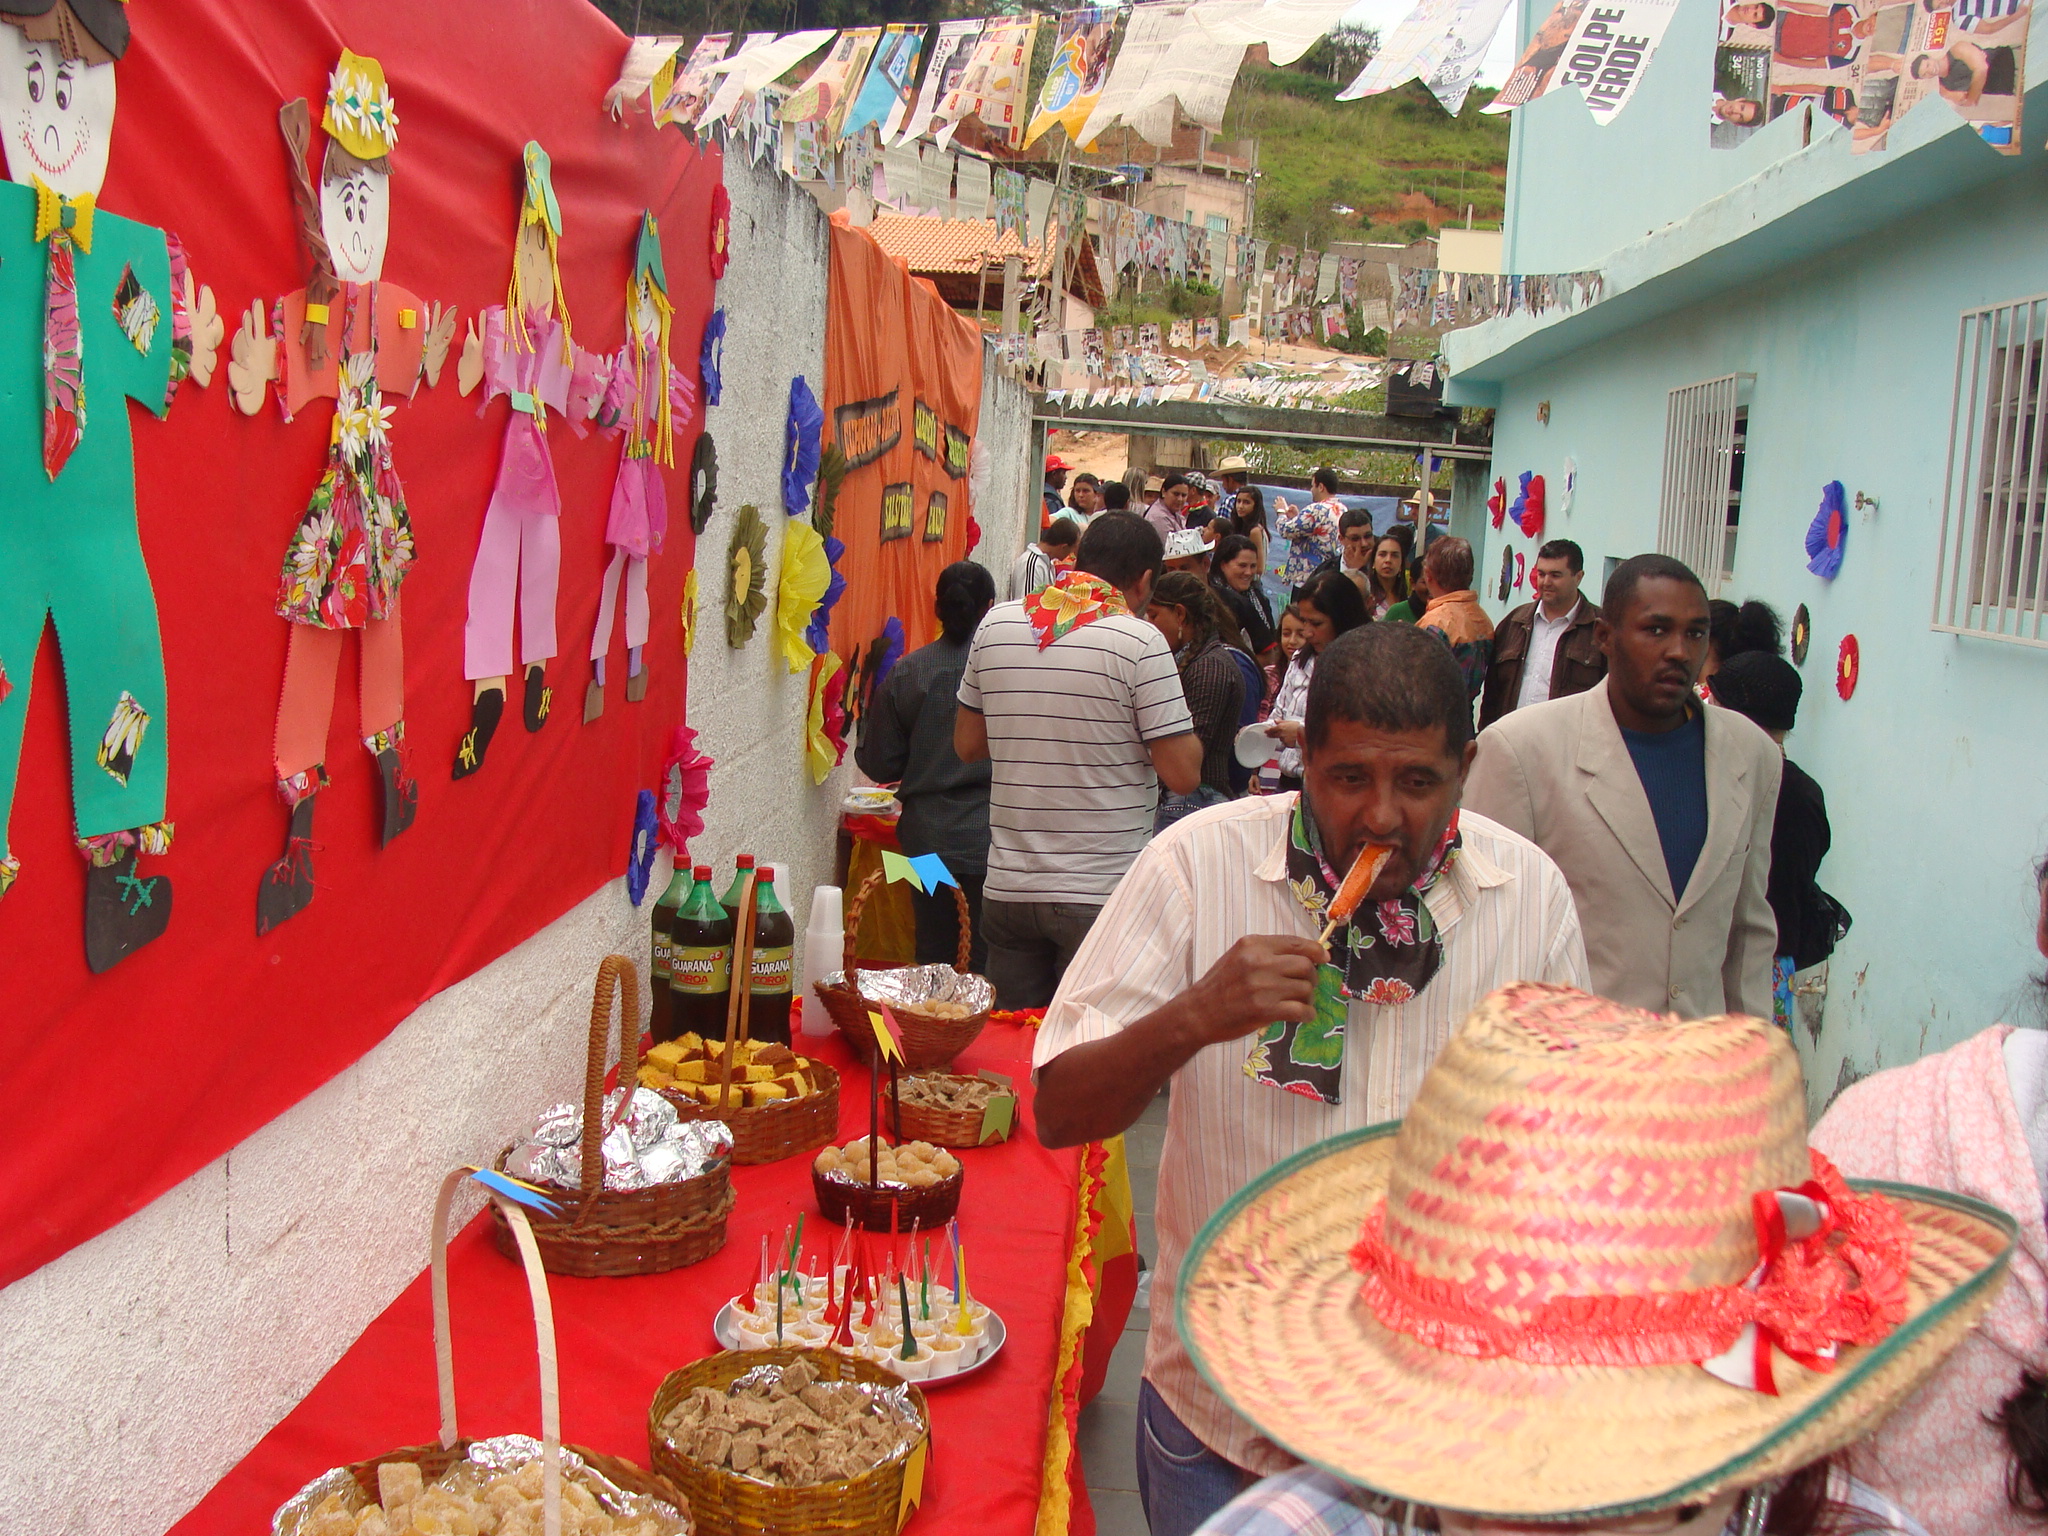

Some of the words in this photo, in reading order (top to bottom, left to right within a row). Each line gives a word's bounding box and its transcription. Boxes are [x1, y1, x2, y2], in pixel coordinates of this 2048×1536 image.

[1561, 8, 1625, 88] GOLPE
[1586, 35, 1650, 111] VERDE
[1756, 56, 1765, 79] NOVO
[674, 972, 708, 984] COROA
[752, 975, 787, 984] COROA
